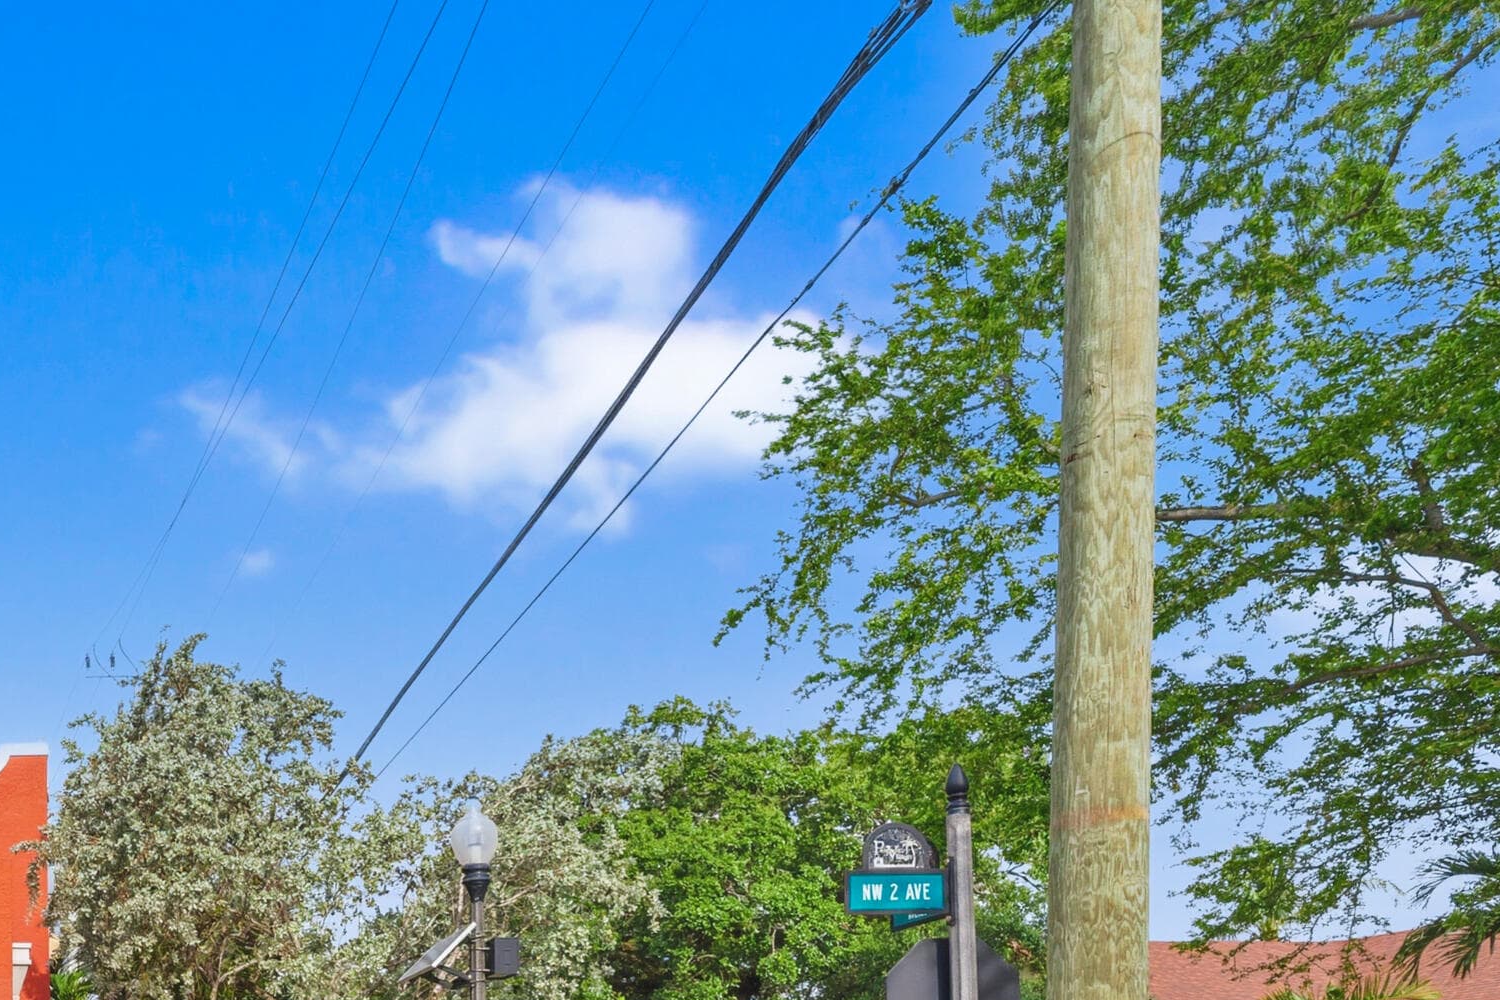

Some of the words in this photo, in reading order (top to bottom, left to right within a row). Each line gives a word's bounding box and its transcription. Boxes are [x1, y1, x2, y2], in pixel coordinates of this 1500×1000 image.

[862, 883, 883, 901] NW
[890, 883, 899, 901] 2
[905, 883, 931, 901] AVE
